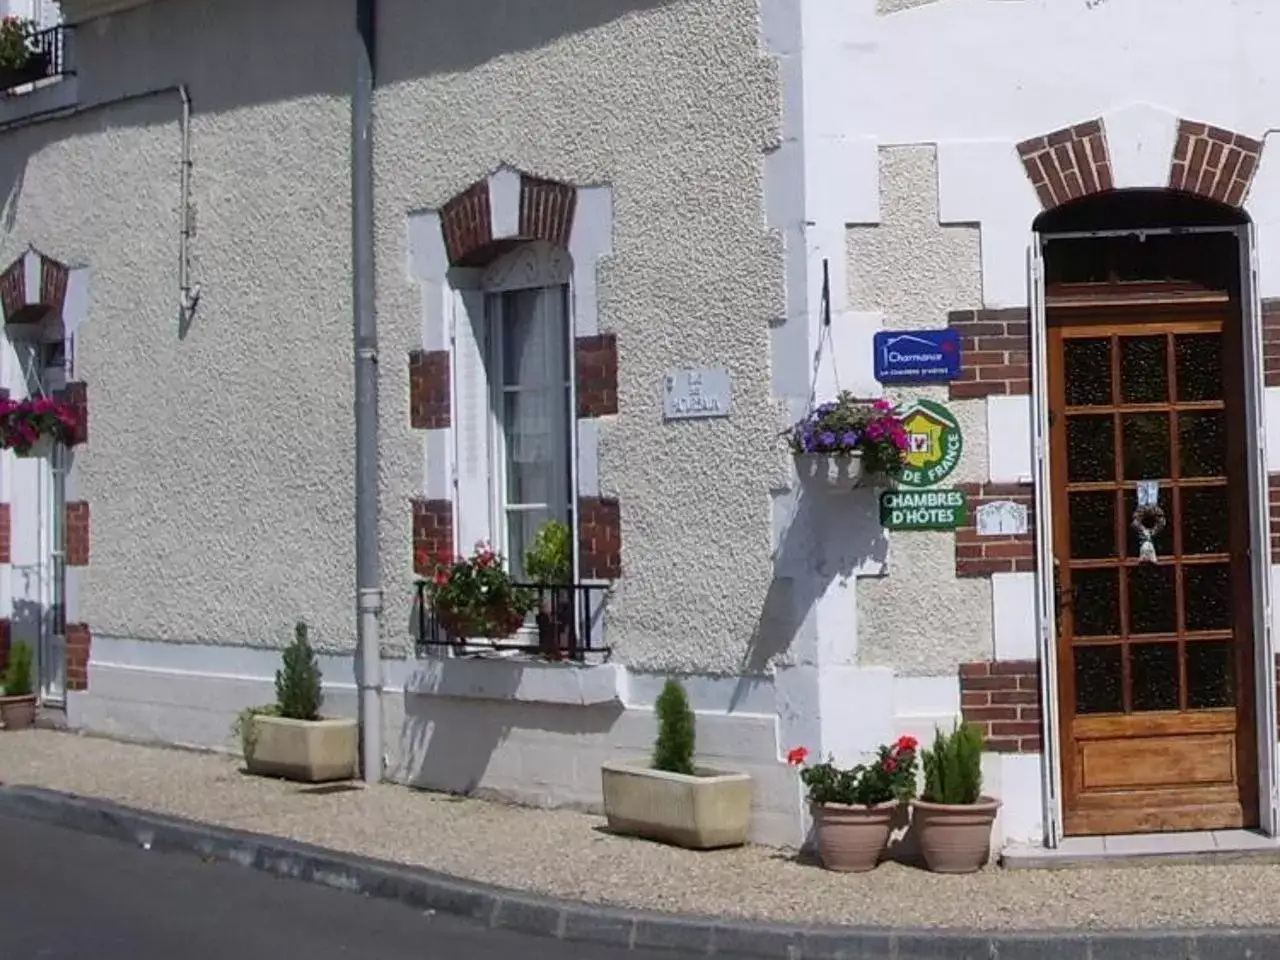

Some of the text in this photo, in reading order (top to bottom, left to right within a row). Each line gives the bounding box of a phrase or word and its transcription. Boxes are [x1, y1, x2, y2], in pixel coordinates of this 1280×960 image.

[902, 433, 959, 483] DE FRANCE
[885, 492, 963, 508] CHAMBRES
[891, 507, 955, 524] D'HÔTES
